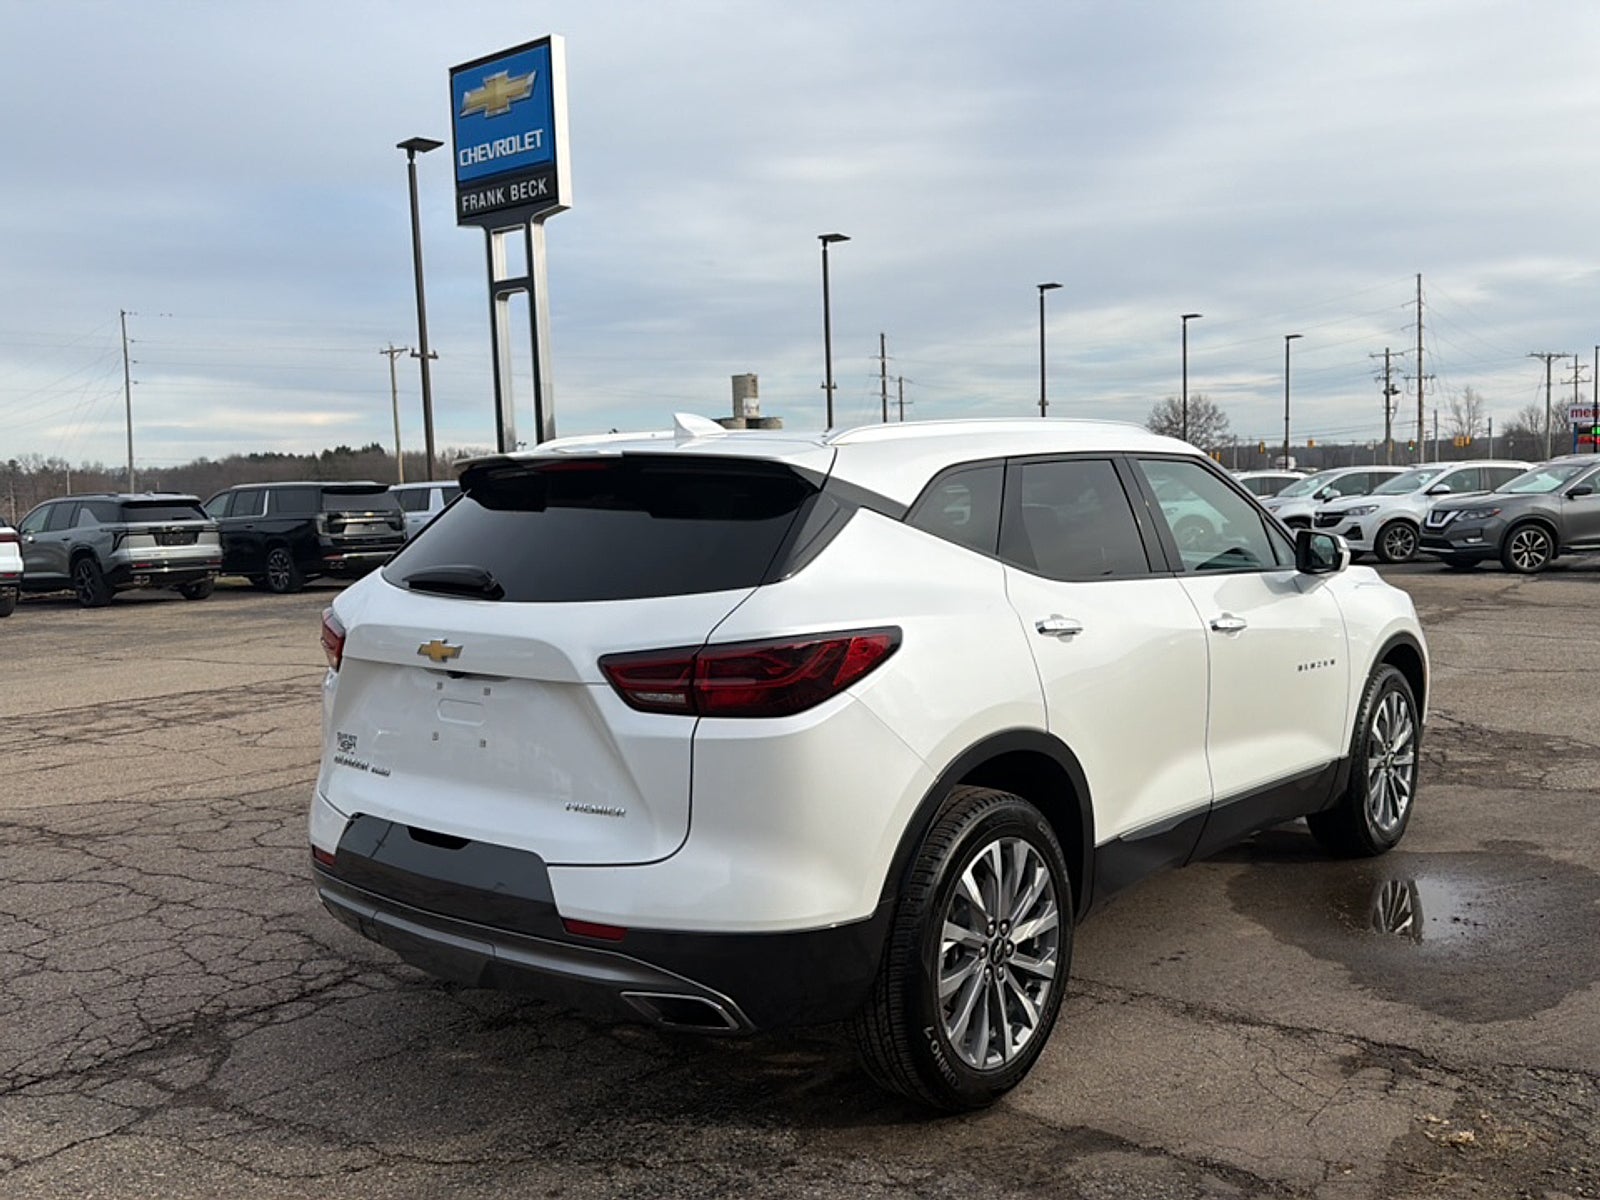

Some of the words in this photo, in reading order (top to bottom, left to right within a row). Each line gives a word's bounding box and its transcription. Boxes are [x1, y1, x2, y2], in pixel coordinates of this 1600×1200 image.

[459, 128, 544, 166] CHEVROLET
[462, 187, 506, 212] FRANK
[510, 177, 548, 201] BECK
[565, 801, 626, 818] PREMIER
